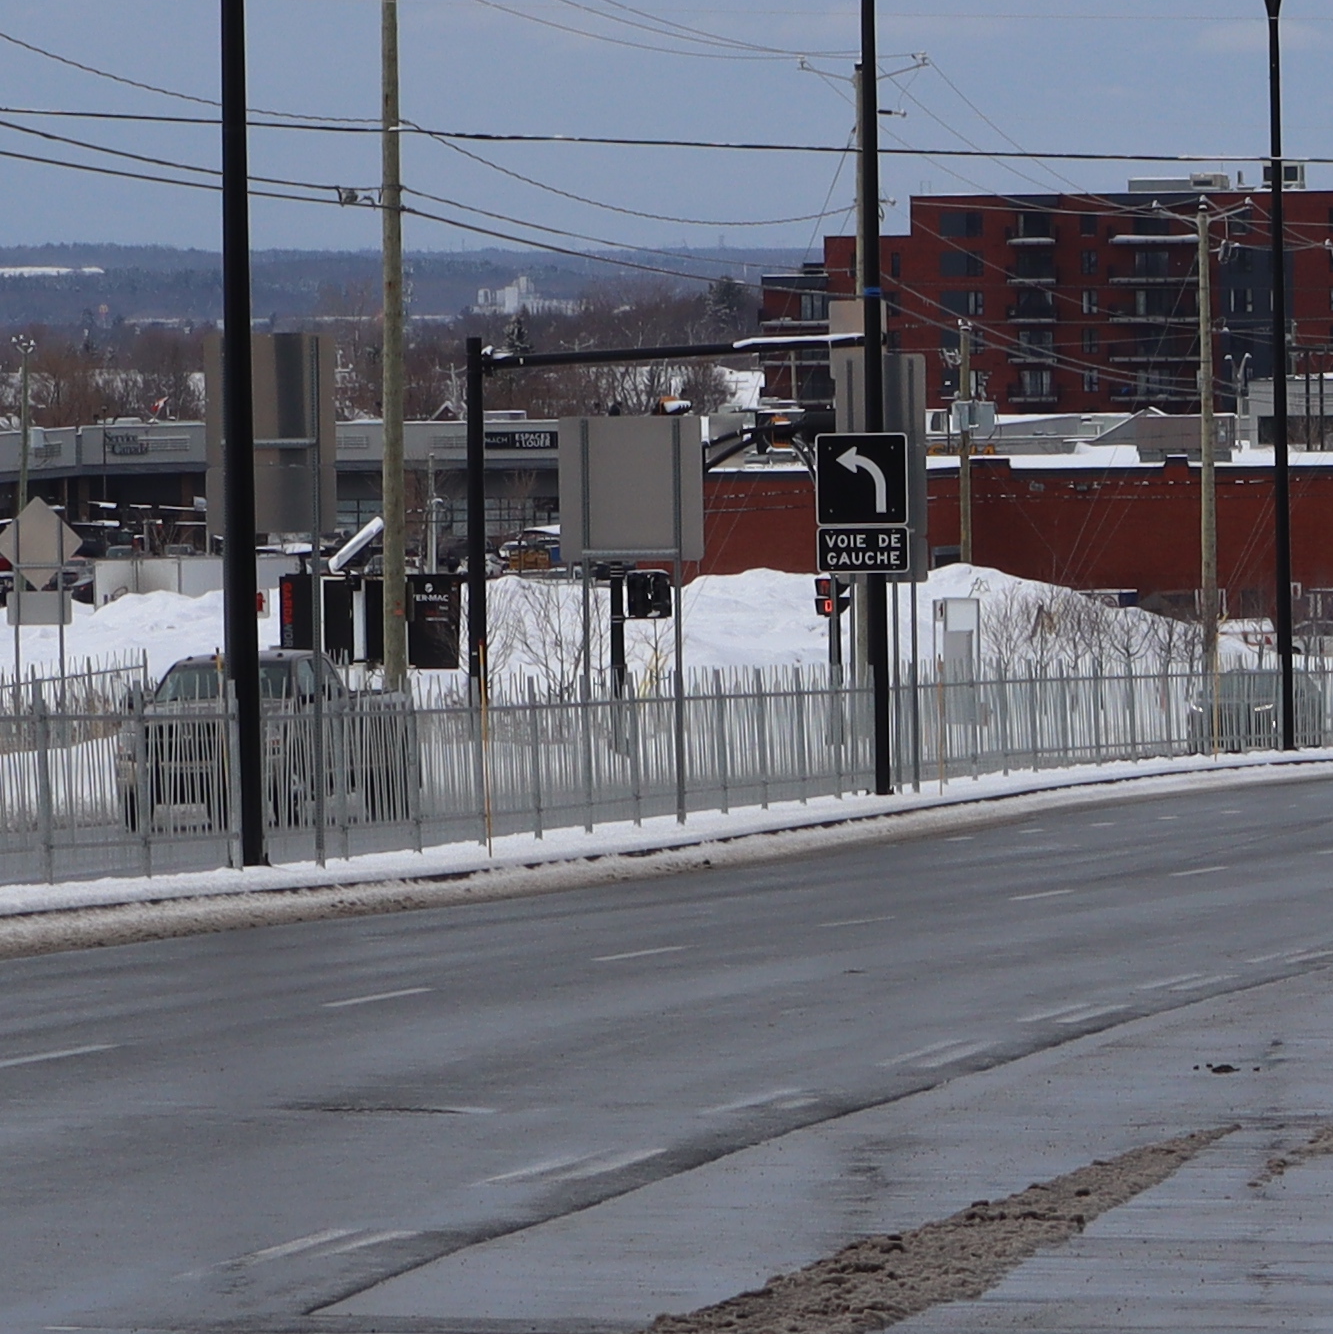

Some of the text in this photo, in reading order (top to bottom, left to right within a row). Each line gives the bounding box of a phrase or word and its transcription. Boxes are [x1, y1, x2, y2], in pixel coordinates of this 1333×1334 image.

[825, 534, 902, 548] VOIE DE
[826, 551, 901, 566] GAUCHE
[413, 594, 449, 602] ER-MAC
